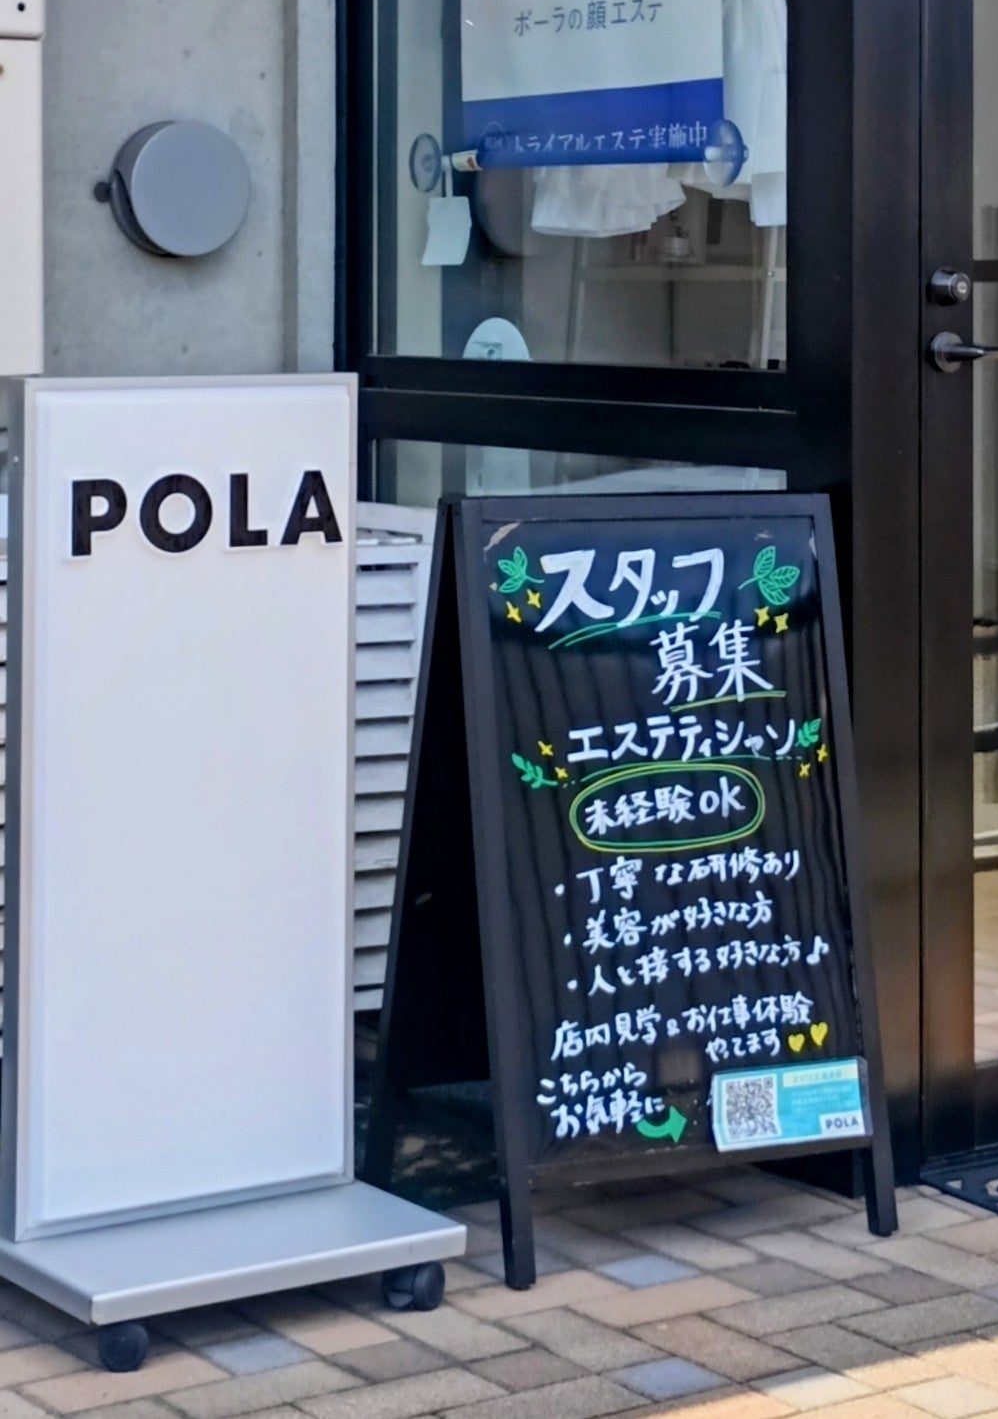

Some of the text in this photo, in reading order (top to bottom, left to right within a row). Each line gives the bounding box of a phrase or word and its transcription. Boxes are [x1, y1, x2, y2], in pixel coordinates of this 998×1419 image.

[71, 470, 343, 557] POLA
[534, 547, 725, 633] スタッフ
[648, 618, 774, 706] 募集
[536, 1061, 648, 1106] こちらから
[550, 1087, 665, 1139] お気軽に
[825, 1116, 860, 1131] POLA
